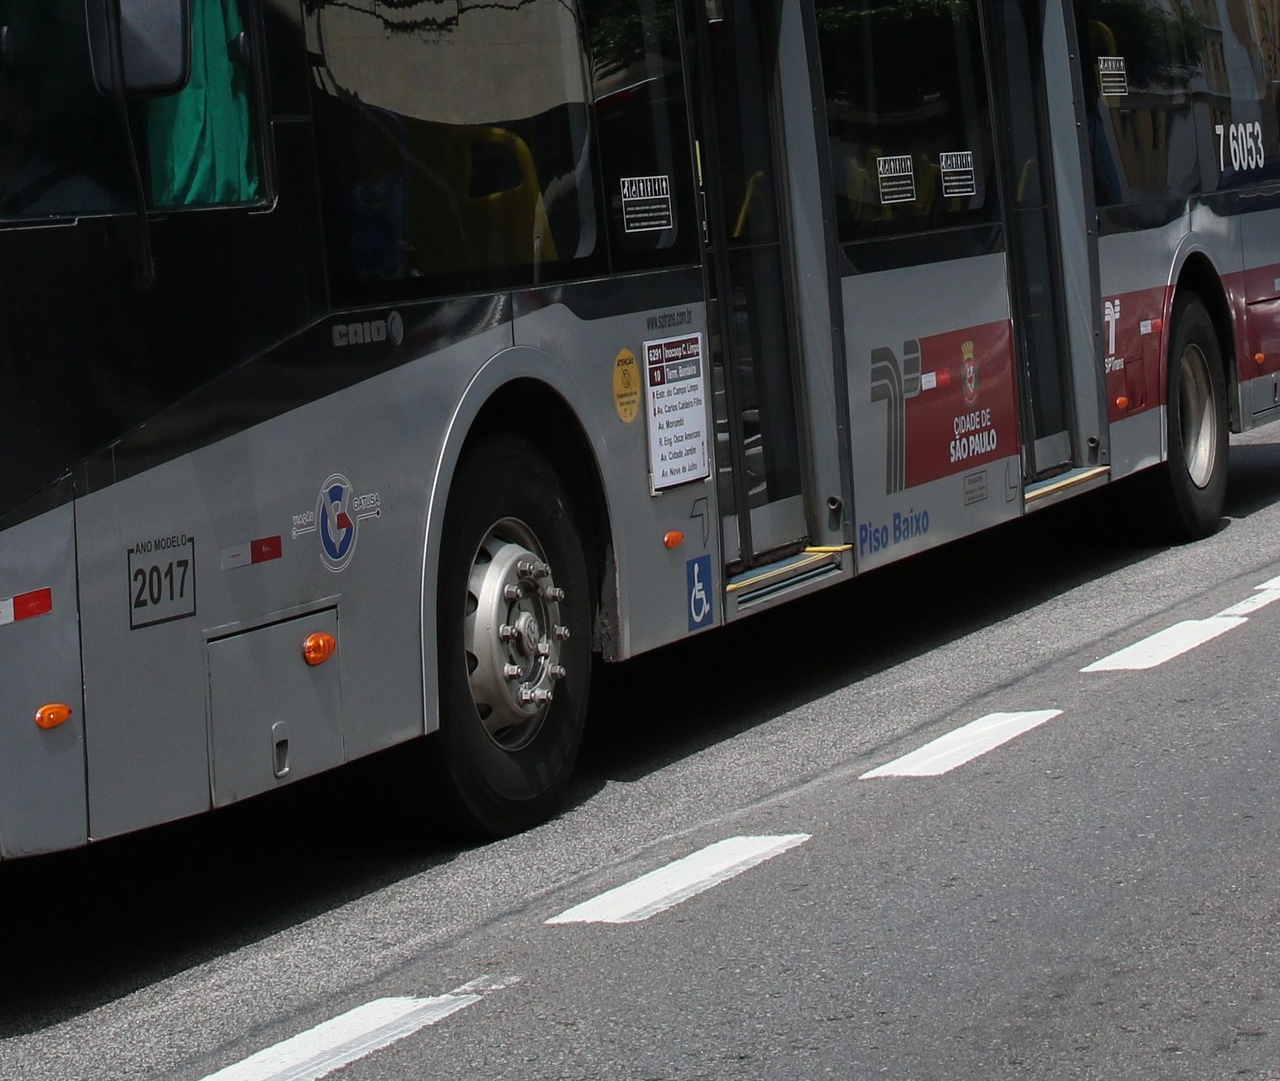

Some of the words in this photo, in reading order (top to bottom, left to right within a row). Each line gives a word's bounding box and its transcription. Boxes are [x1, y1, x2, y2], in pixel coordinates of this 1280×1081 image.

[1215, 125, 1225, 171] 7
[1229, 121, 1264, 172] 6053
[331, 320, 387, 347] CAIO
[953, 411, 980, 436] CIDADE
[981, 408, 991, 428] DE
[949, 436, 967, 463] SÃO
[968, 429, 997, 458] PAULO
[353, 492, 381, 511] GATUSA
[135, 540, 153, 554] ANO
[153, 534, 187, 550] MODELO
[858, 521, 888, 557] Piso
[892, 508, 929, 544] Baixo
[133, 559, 189, 609] 2017
